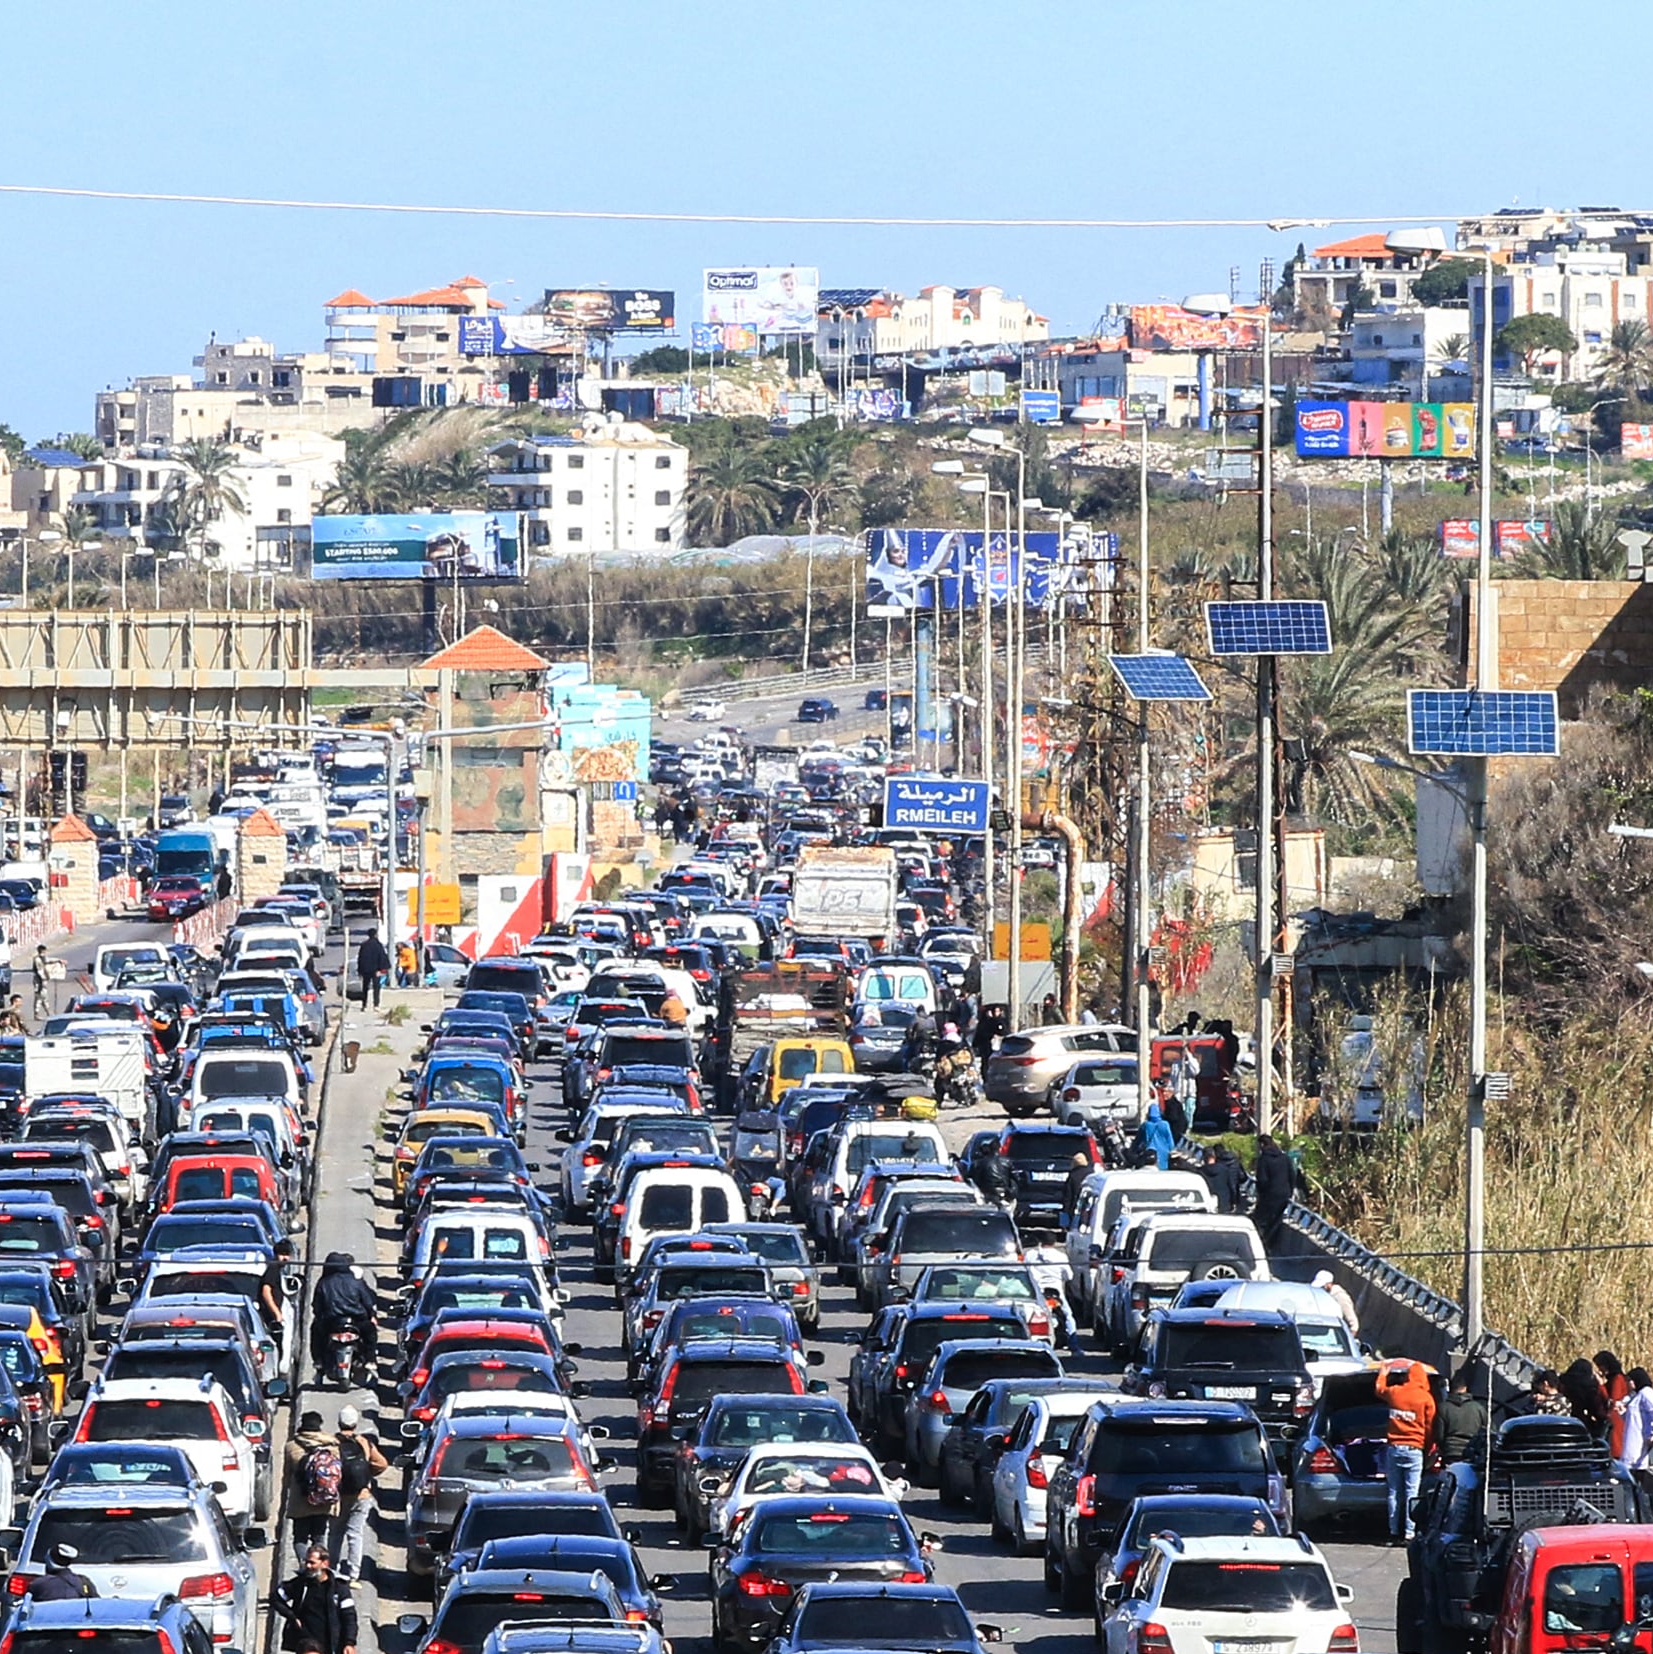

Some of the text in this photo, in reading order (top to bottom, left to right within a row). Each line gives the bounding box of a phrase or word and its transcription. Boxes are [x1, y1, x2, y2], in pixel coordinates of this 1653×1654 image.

[625, 300, 661, 311] BOSS
[897, 783, 976, 803] الرميلة
[896, 809, 976, 825] RMEILEH
